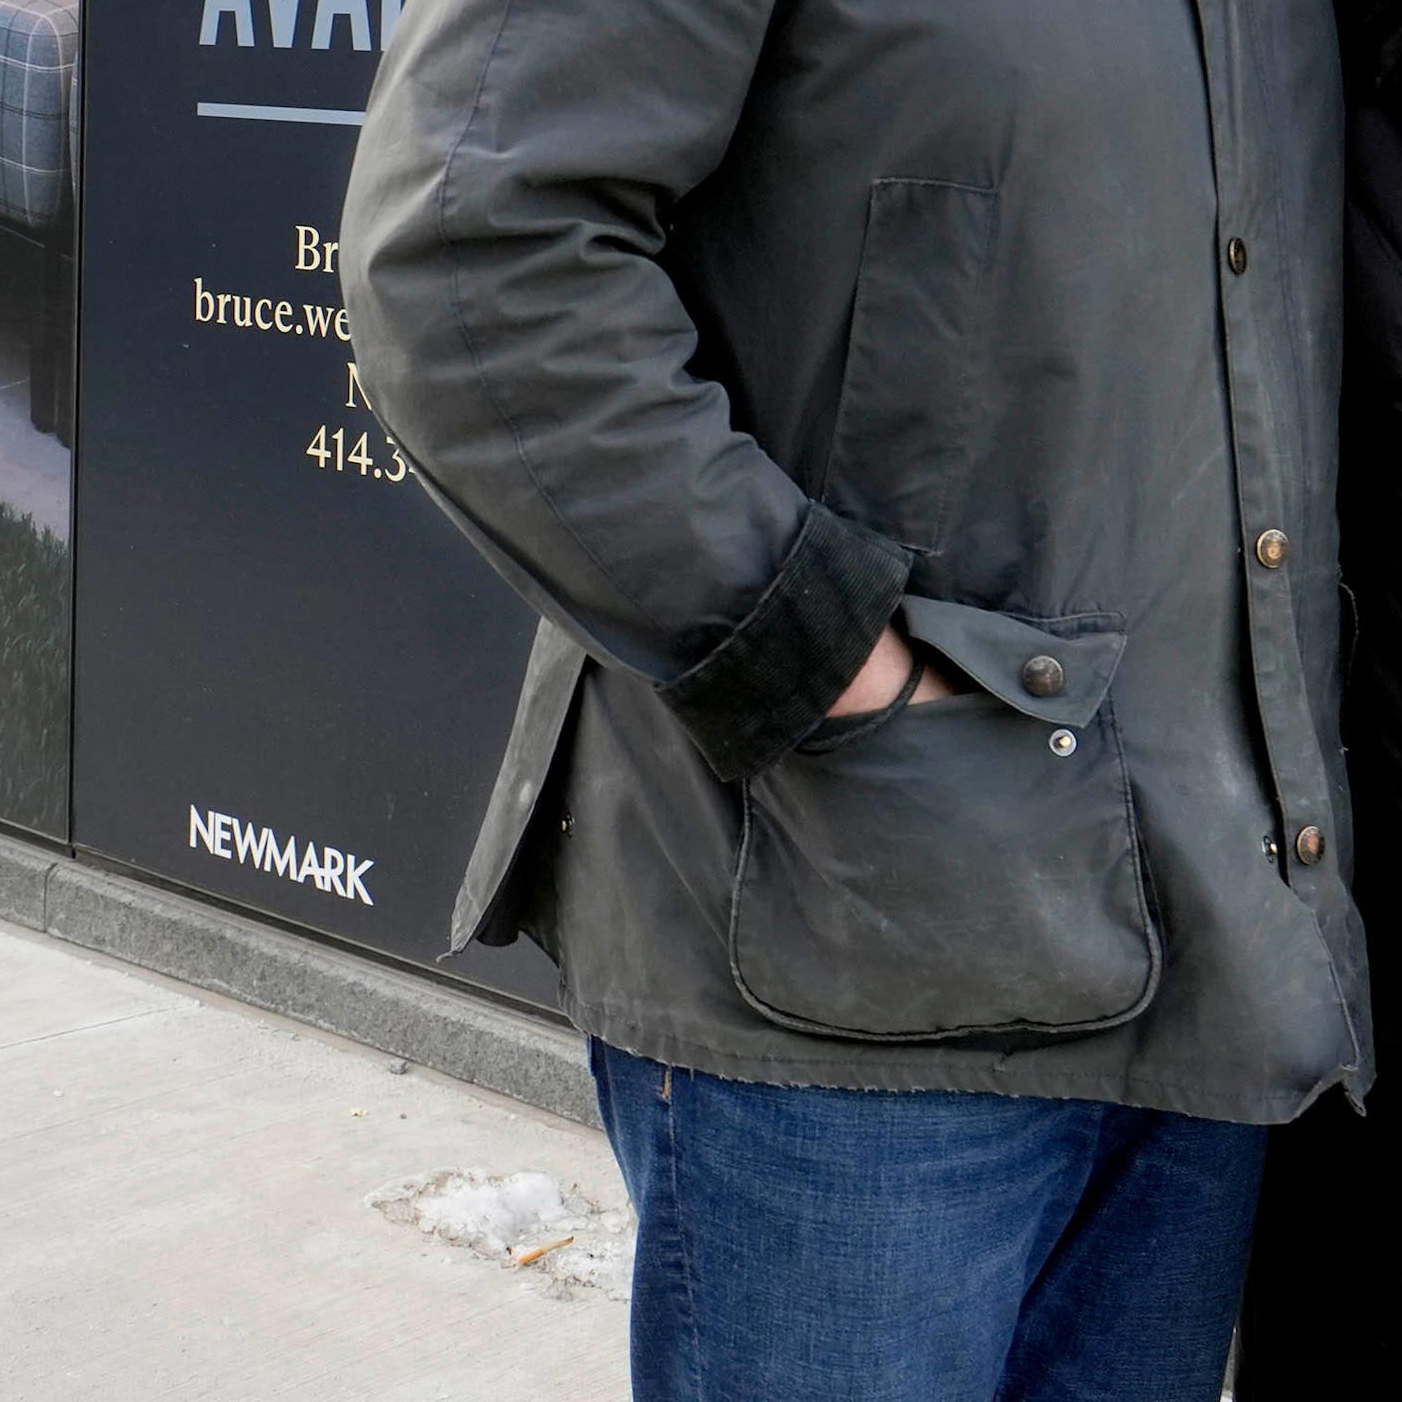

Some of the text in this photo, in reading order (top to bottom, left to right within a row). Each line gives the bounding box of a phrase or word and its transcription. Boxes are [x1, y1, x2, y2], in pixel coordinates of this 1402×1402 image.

[194, 278, 352, 341] bruce.we
[306, 424, 417, 482] 414.3
[189, 804, 374, 906] NEWMARK
